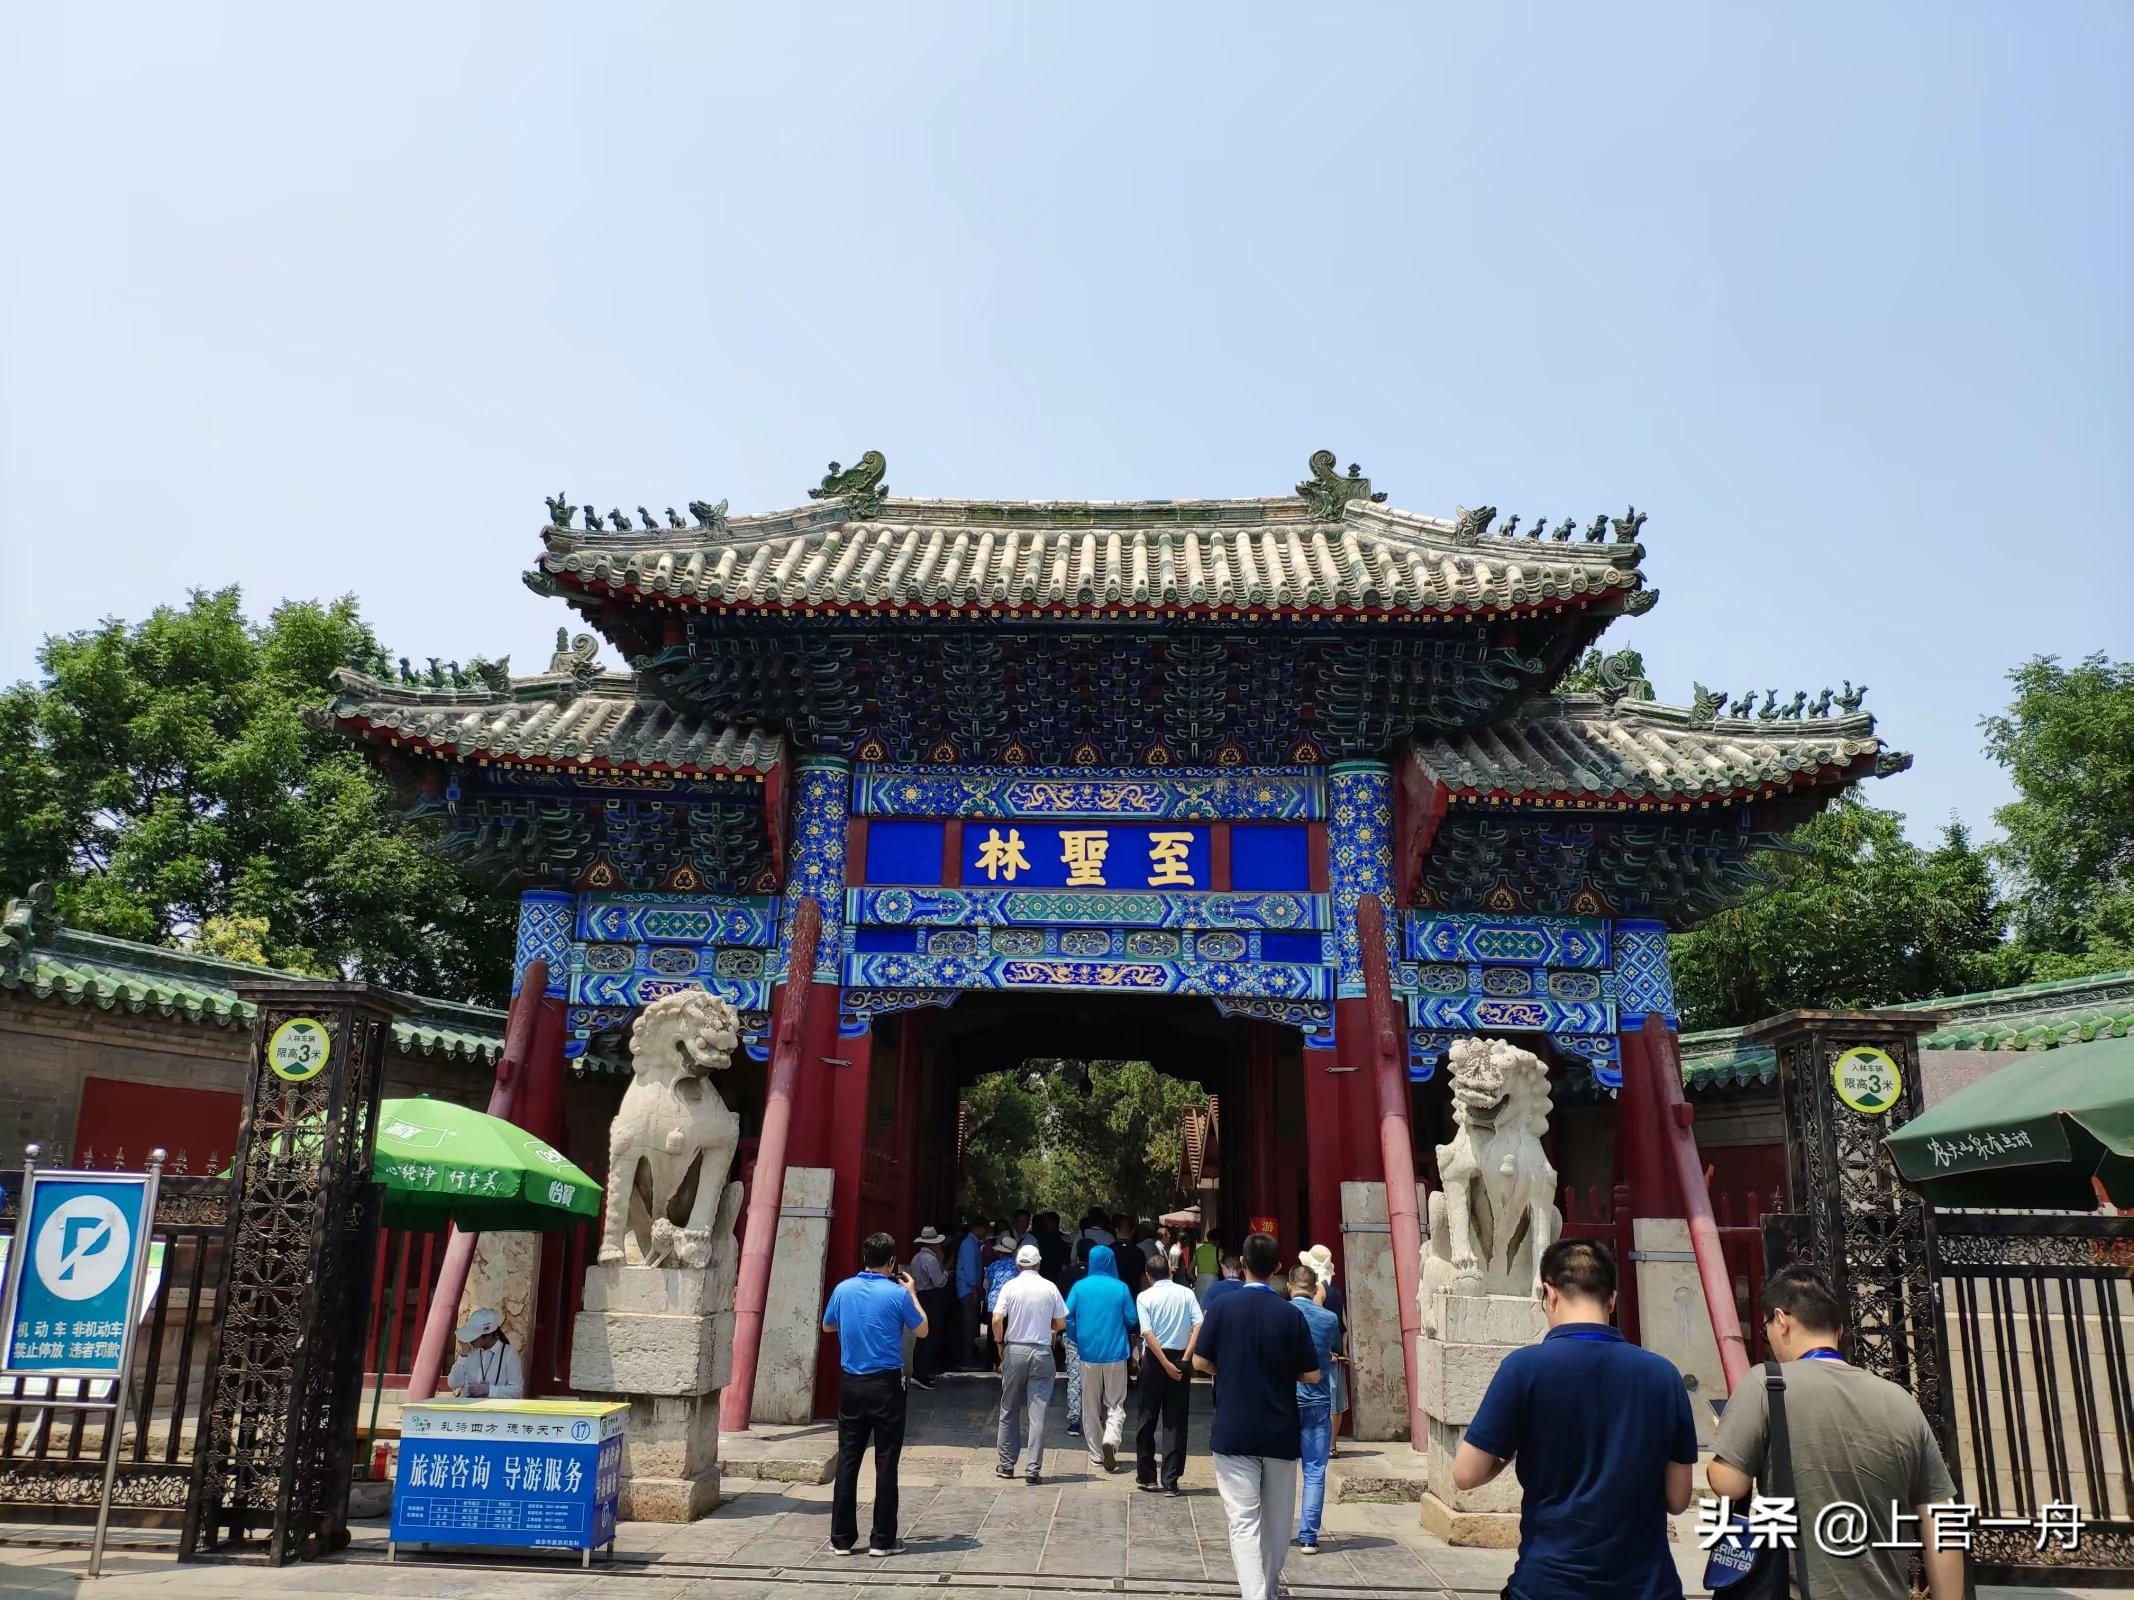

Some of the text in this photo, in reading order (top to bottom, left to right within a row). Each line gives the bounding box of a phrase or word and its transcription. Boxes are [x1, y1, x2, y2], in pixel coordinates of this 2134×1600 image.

[277, 1044, 322, 1062] 限高3米
[1851, 1063, 1884, 1073] 入林车辆
[1844, 1074, 1893, 1093] 限高3米
[1927, 1130, 2033, 1167] 农夫山泉有点甜
[71, 1321, 124, 1339] 非机动车
[13, 1342, 121, 1358] 禁止停放 违者罚款
[408, 1453, 492, 1489] 旅游咨询
[502, 1456, 583, 1494] 导游服务
